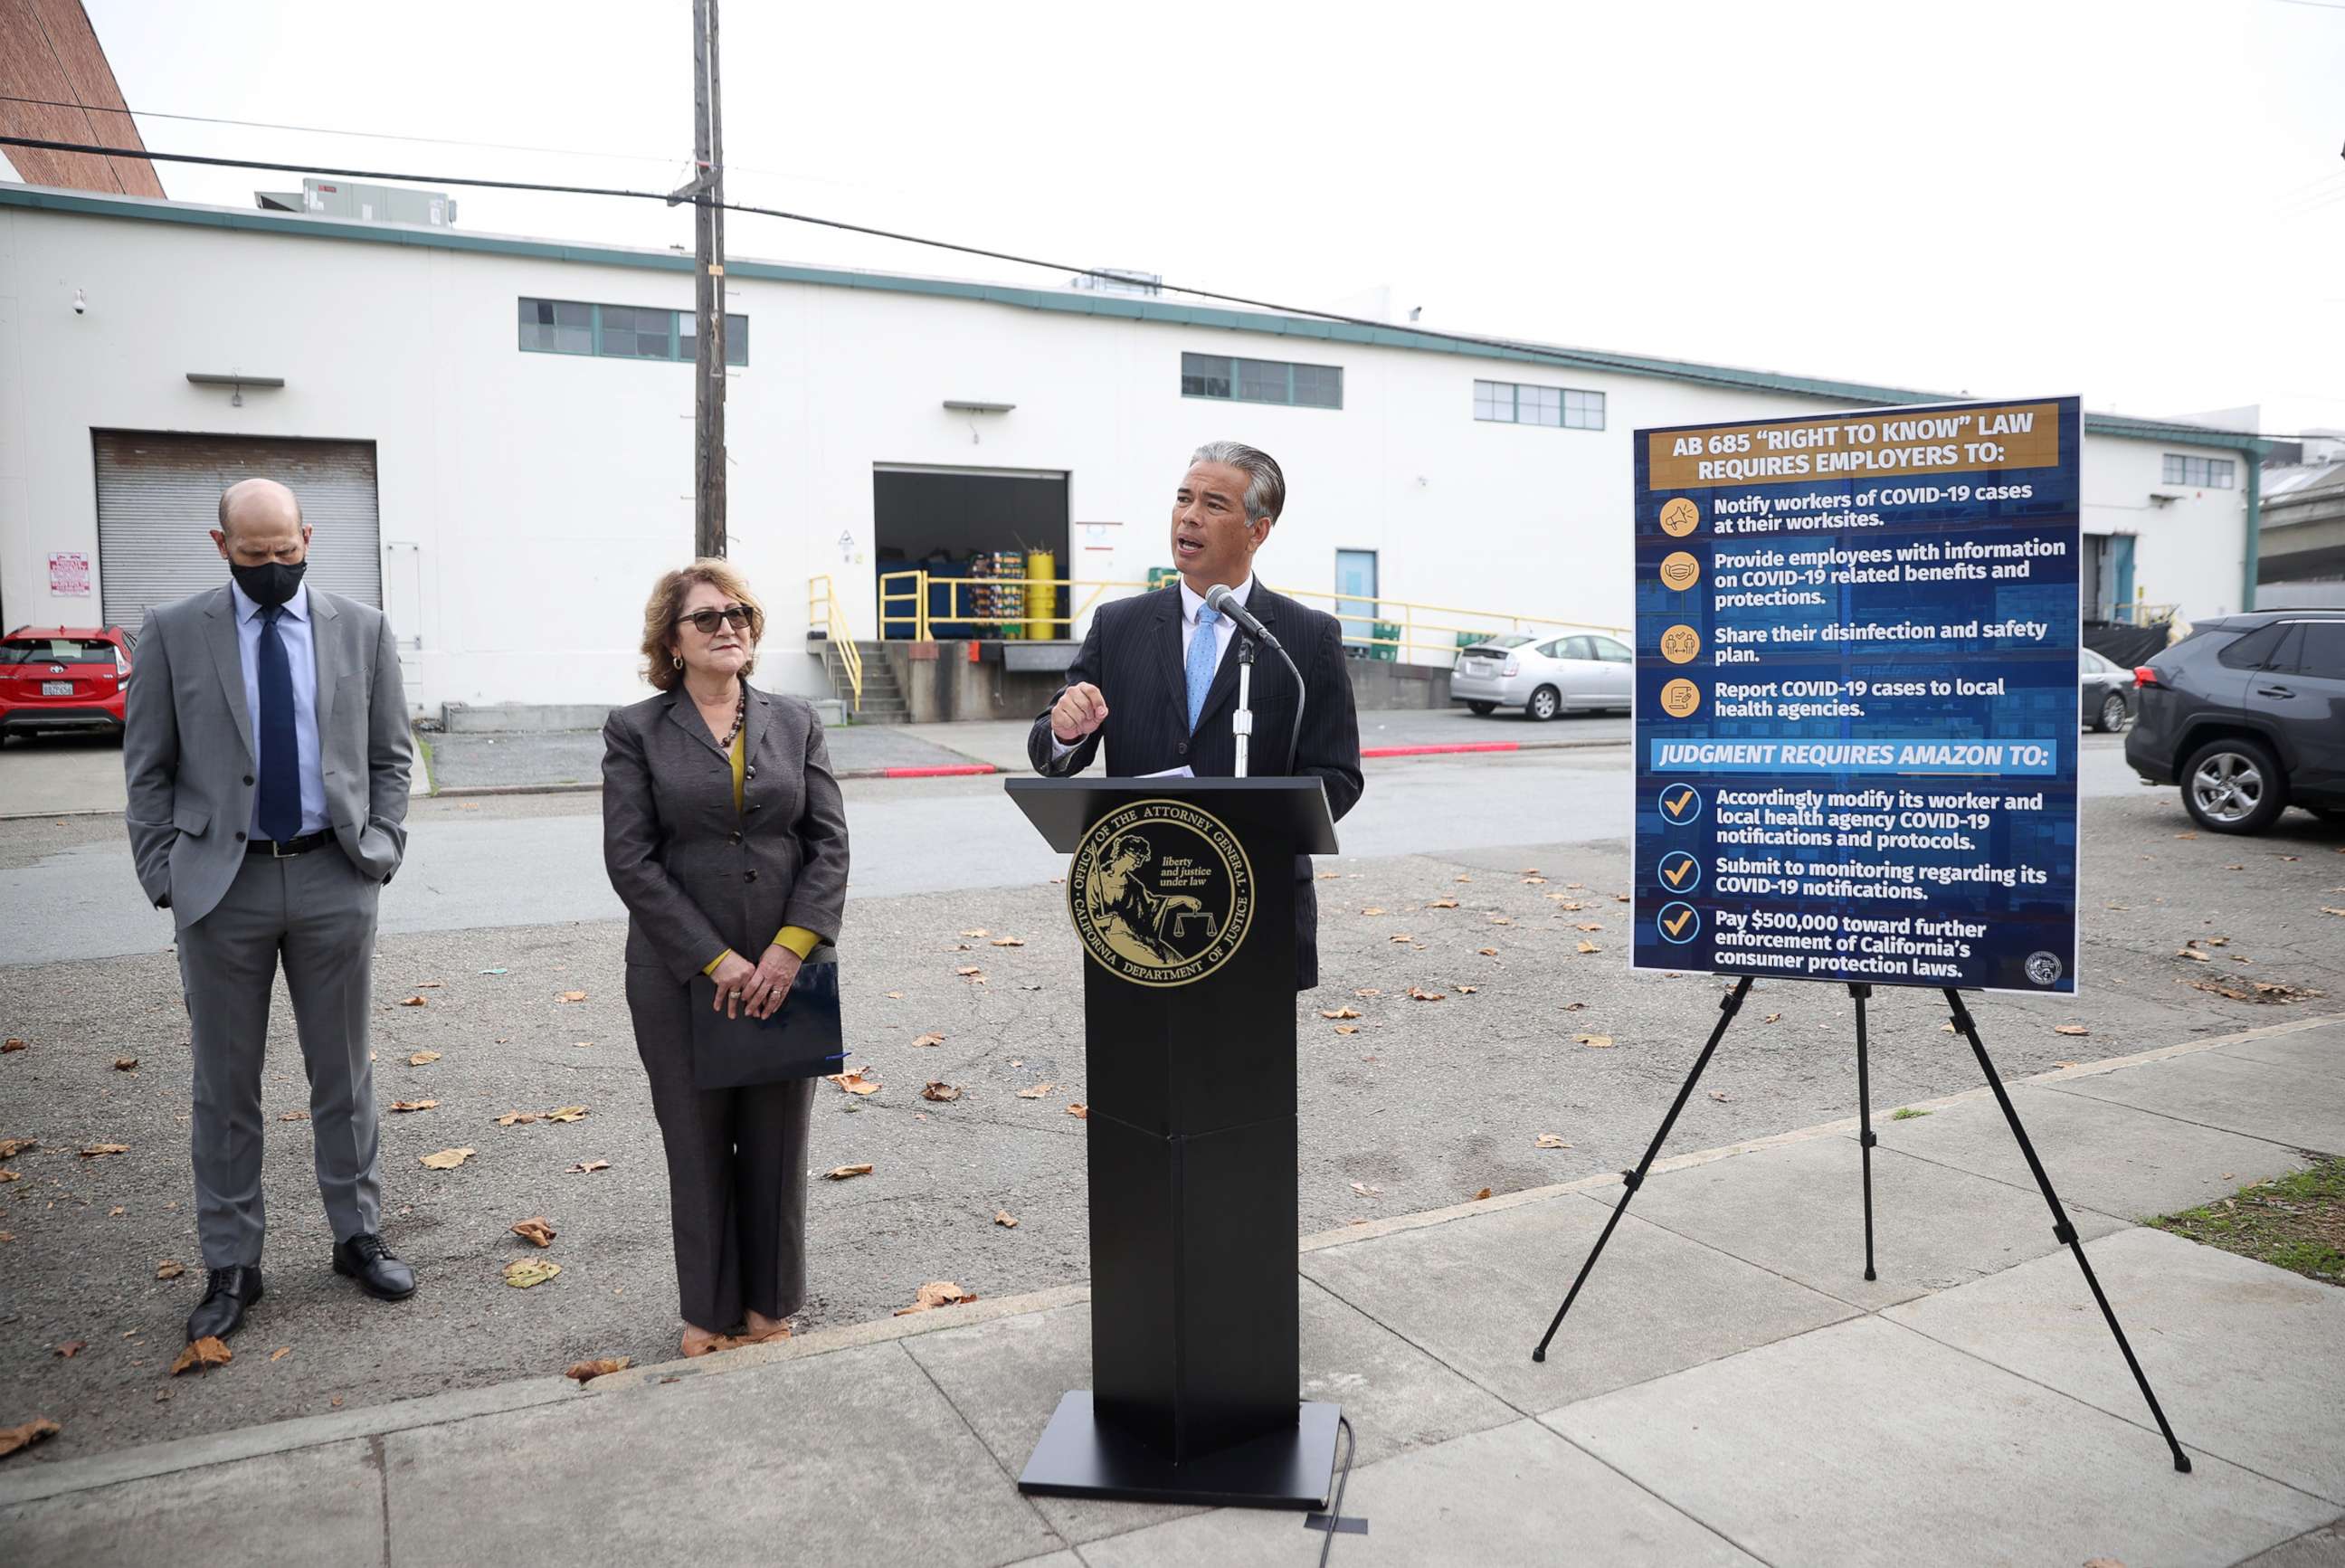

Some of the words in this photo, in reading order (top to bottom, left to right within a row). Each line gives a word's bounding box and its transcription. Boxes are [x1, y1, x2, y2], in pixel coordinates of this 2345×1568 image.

[1672, 436, 1704, 457] AB
[1707, 433, 1752, 455] 685
[1756, 426, 1839, 451] “RIGHT
[1843, 423, 1876, 445] TO
[1882, 414, 1971, 442] KNOW”
[1978, 412, 2034, 436] LAW
[1698, 453, 1810, 481] REQUIRES
[1816, 444, 1959, 473] EMPLOYERS
[1963, 442, 2005, 463] TO:
[1714, 495, 1774, 518] Notify
[1773, 492, 1852, 511] workers
[1855, 489, 1878, 508] of
[1880, 485, 1970, 506] COVID-19
[1975, 484, 2033, 500] cases
[1714, 518, 1734, 534] at
[1736, 513, 1783, 533] their
[1785, 509, 1885, 530] worksites.
[1714, 549, 1785, 569] Provide
[1789, 547, 1893, 569] employees
[1895, 542, 1940, 562] with
[1944, 537, 2065, 559] information
[1714, 575, 1738, 588] on
[1742, 568, 1827, 587] COVID-19
[1830, 565, 1900, 584] related
[1904, 562, 1987, 582] benefits
[1991, 559, 2030, 579] and
[1714, 591, 1827, 612] protections.
[1714, 626, 1768, 643] Share
[1771, 623, 1818, 642] their
[1820, 621, 1935, 641] disinfection
[1940, 620, 1978, 639] and
[1982, 619, 2047, 641] safety
[1715, 646, 1761, 667] plan.
[1715, 682, 1779, 701] Report
[1781, 680, 1867, 698] COVID-19
[1871, 682, 1926, 697] cases
[1930, 679, 1951, 696] to
[1956, 678, 2005, 696] local
[1715, 699, 1773, 717] health
[1777, 698, 1866, 721] agencies.
[1658, 744, 1777, 766] JUDGMENT
[1780, 745, 1894, 767] REQUIRES
[1898, 745, 2003, 765] AMAZON
[2009, 746, 2049, 765] TO:
[1716, 788, 1824, 810] Accordingly
[1828, 789, 1895, 812] modify
[1898, 789, 1924, 808] its
[1928, 792, 2000, 810] worker
[2004, 793, 2043, 811] and
[1716, 807, 1761, 825] local
[1765, 807, 1825, 827] health
[1828, 812, 1896, 832] agency
[1900, 812, 1990, 830] COVID-19
[1074, 845, 1094, 889] OFFICE
[1095, 825, 1111, 842] OF
[1110, 810, 1138, 829] THE
[1144, 806, 1213, 832] ATTORNEY
[1213, 831, 1248, 888] GENERAL
[1716, 826, 1833, 846] notifications
[1836, 830, 1872, 847] and
[1876, 832, 1976, 851] protocols.
[1161, 867, 1179, 877] and
[1180, 866, 1212, 878] justice
[1162, 856, 1193, 868] liberty
[1716, 856, 1781, 875] Submit
[1784, 860, 1805, 876] to
[1809, 859, 1914, 884] monitoring
[1919, 863, 2017, 887] regarding
[2021, 864, 2047, 884] its
[1160, 877, 1188, 887] under
[1190, 876, 1207, 886] law
[1715, 876, 1799, 895] COVID-19
[1802, 878, 1928, 900] notifications.
[1715, 910, 1748, 931] Pay
[1751, 909, 1838, 933] $500,000
[1842, 917, 1911, 935] toward
[1914, 917, 1987, 938] further
[1074, 898, 1117, 965] CALIFORNIA
[1123, 961, 1204, 981] DEPARTMENT
[1208, 947, 1224, 964] OF
[1224, 897, 1248, 946] JUSTICE
[1714, 929, 1833, 951] enforcement
[1836, 935, 1858, 952] of
[1860, 935, 1970, 961] California’s
[1714, 951, 1805, 968] consumer
[1808, 955, 1908, 974] protection
[1913, 957, 1963, 978] laws.
